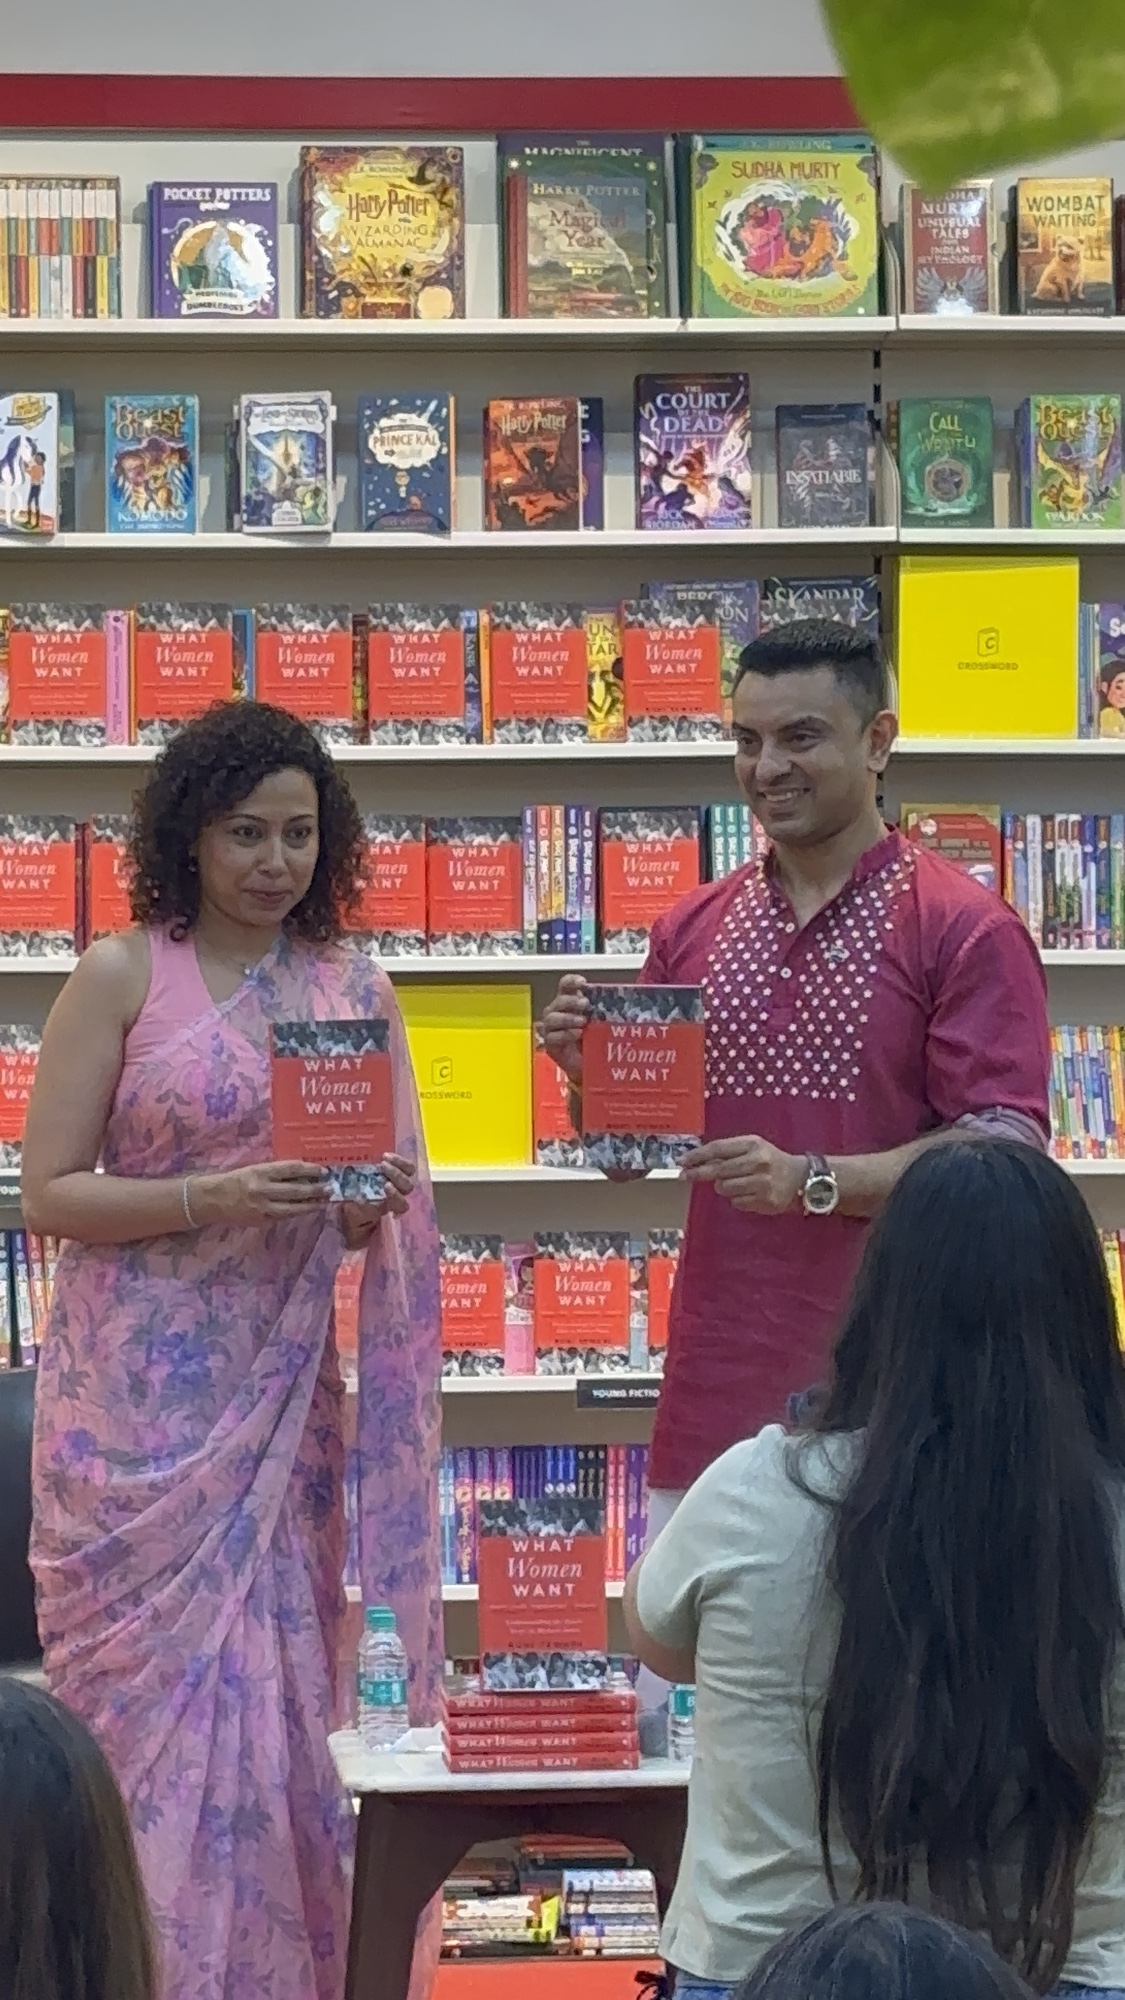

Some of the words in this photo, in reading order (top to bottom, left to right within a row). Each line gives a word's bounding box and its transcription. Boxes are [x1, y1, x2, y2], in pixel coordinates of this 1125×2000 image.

[731, 161, 786, 179] SUDHA
[790, 161, 841, 180] MURTY
[163, 188, 213, 201] POCKET
[216, 188, 271, 201] POTTERS
[532, 183, 580, 196] HARRY
[586, 185, 641, 196] POTTER
[348, 192, 387, 222] Harry
[387, 189, 430, 217] Potter
[1026, 195, 1105, 212] WOMBAT
[917, 217, 981, 228] UNUSUAL
[1033, 214, 1097, 228] WAITING
[564, 230, 606, 248] Year
[932, 228, 969, 239] TALES
[355, 237, 424, 249] ALMANAC
[930, 246, 970, 255] INDIAN
[656, 392, 731, 409] COURT
[115, 404, 186, 424] Beast
[1040, 403, 1114, 426] Beast
[501, 413, 533, 436] Harry
[533, 411, 567, 434] Potter
[663, 416, 724, 433] DEAD
[929, 411, 963, 433] CALL
[116, 420, 183, 440] Quest
[373, 434, 413, 449] PRINCE
[785, 470, 862, 485] INSATIABLE
[118, 510, 188, 522] KOMODO
[34, 634, 82, 645] WHAT
[160, 633, 207, 644] WHAT
[279, 634, 330, 645] WHAT
[392, 633, 441, 645] WHAT
[515, 632, 563, 643] WHAT
[649, 630, 697, 641] WHAT
[985, 637, 996, 650] C
[31, 646, 89, 664] Women
[156, 646, 215, 664] Women
[278, 646, 335, 664] Women
[389, 647, 447, 663] Women
[512, 645, 569, 663] Women
[645, 643, 703, 661] Women
[35, 668, 84, 678] WANT
[160, 667, 209, 677] WANT
[281, 667, 331, 678] WANT
[392, 667, 441, 678] WANT
[515, 666, 564, 677] WANT
[649, 663, 698, 674] WANT
[957, 662, 1019, 671] CROSSWORD
[2, 845, 50, 856] WHAT
[370, 844, 402, 856] HAT
[452, 847, 499, 857] WHAT
[625, 843, 675, 854] WHAT
[0, 859, 57, 876] Women
[375, 863, 408, 875] men
[448, 860, 506, 877] Women
[622, 856, 680, 873] Women
[2, 879, 51, 890] WANT
[452, 880, 500, 891] WANT
[626, 875, 675, 887] WANT
[611, 1025, 669, 1038] WHAT
[607, 1041, 677, 1064] Women
[304, 1058, 363, 1072] WHAT
[611, 1067, 670, 1081] WANT
[301, 1075, 372, 1097] Women
[420, 1091, 472, 1099] ROSSWORD
[306, 1100, 367, 1115] WANT
[558, 1262, 606, 1273] WHAT
[554, 1275, 612, 1292] Women
[559, 1295, 607, 1306] WANT
[592, 1389, 627, 1398] YOUNG
[628, 1388, 661, 1398] FICTIO
[512, 1539, 574, 1553] WHAT
[507, 1557, 582, 1579] Women
[512, 1583, 576, 1597] WANT
